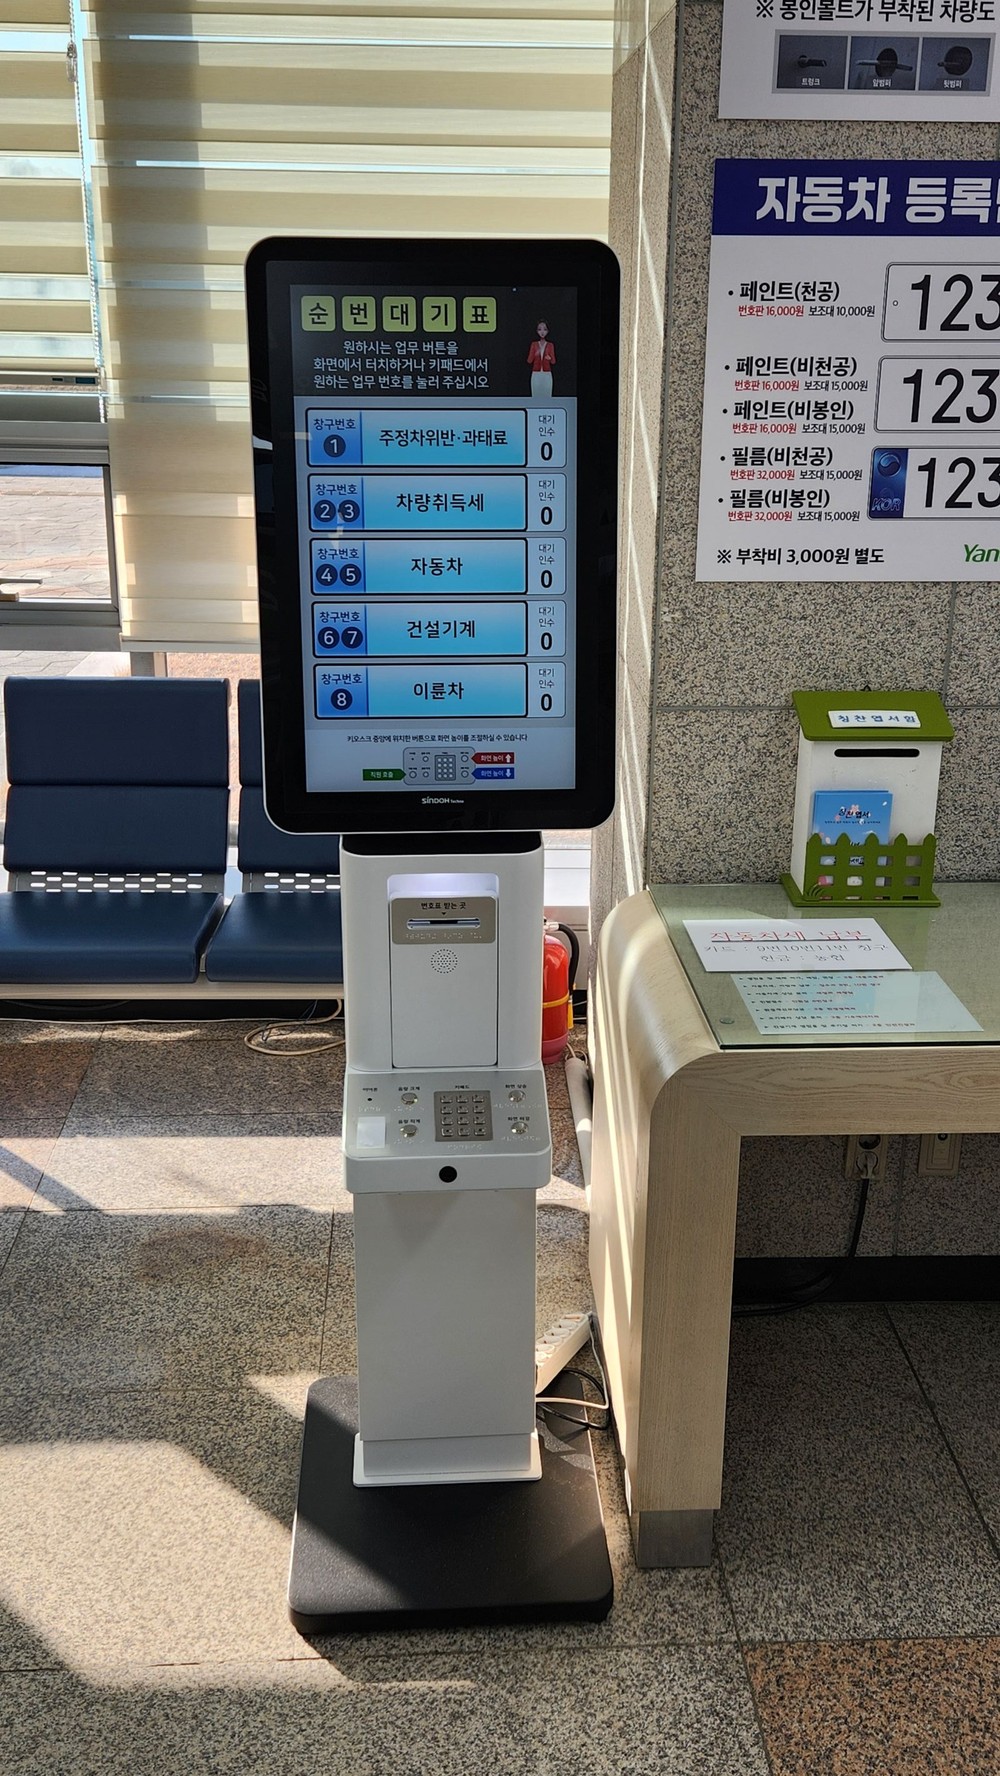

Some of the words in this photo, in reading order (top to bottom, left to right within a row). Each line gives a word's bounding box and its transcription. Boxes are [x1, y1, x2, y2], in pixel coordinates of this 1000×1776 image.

[879, 0, 933, 22] 부착된
[940, 0, 995, 23] 차량도
[802, 77, 821, 86] 트렁크
[872, 78, 892, 88] 앞범퍼
[943, 79, 962, 89] 뒷범퍼
[756, 176, 891, 223] 자동차
[905, 177, 1000, 224] 등록
[739, 280, 841, 302] 페인트(천공)
[910, 273, 1000, 332] 123
[738, 305, 764, 317] 번호판
[765, 305, 805, 318] 16,000원
[808, 306, 835, 317] 보조대
[836, 305, 876, 318] 10,000원
[343, 341, 392, 355] 원하시는
[395, 341, 419, 355] 업무
[423, 341, 459, 355] 버튼을
[313, 358, 362, 372] 화면에서
[366, 358, 426, 372] 터치하거나
[429, 358, 488, 372] 키패드에서
[735, 356, 858, 377] 페인트(비천공)
[313, 375, 349, 389] 원하는
[352, 375, 376, 389] 업무
[379, 375, 414, 389] 번호를
[417, 375, 440, 389] 눌러
[442, 375, 489, 389] 주십시오
[734, 380, 760, 391] 번호판
[761, 380, 800, 392] 16,000원
[804, 380, 830, 391] 보조대
[831, 380, 868, 392] 15,000원
[902, 368, 1000, 424] 123
[733, 399, 855, 420] 페인트(비봉인)
[313, 418, 356, 431] 창구번호
[538, 414, 555, 425] 대기
[538, 426, 555, 437] 인수
[732, 423, 758, 434] 번호판
[759, 423, 797, 435] 16,000원
[802, 423, 828, 434] 보조대
[829, 423, 866, 435] 15,000원
[379, 429, 508, 448] 주정차위반·과태료
[541, 442, 553, 461] 0
[731, 446, 834, 467] 필름(비천공)
[730, 469, 756, 481] 번호판
[757, 469, 796, 481] 32,000원
[799, 470, 825, 481] 보조대
[826, 469, 863, 481] 15,000원
[315, 483, 358, 496] 창구번호
[538, 480, 555, 490] 대기
[396, 493, 485, 513] 차량취득세
[538, 491, 555, 502] 인수
[729, 488, 831, 509] 필름(비봉인)
[871, 497, 902, 512] KOR
[541, 506, 553, 525] 0
[728, 511, 753, 522] 번호판
[754, 511, 793, 523] 32,000원
[797, 511, 823, 522] 보조대
[824, 511, 861, 523] 15,000원
[317, 548, 359, 560] 창구번호
[538, 544, 555, 553] 대기
[538, 555, 555, 565] 인수
[736, 548, 782, 565] 부착비
[786, 548, 851, 565] 3,000원
[854, 548, 885, 564] 별도
[410, 557, 464, 576] 자동차
[541, 569, 553, 588] 0
[319, 611, 361, 623] 창구번호
[538, 606, 555, 616] 대기
[538, 617, 555, 627] 인수
[406, 619, 476, 639] 건설기계
[541, 632, 553, 651] 0
[321, 673, 363, 685] 창구번호
[538, 668, 555, 677] 대기
[538, 679, 555, 689] 인수
[412, 681, 465, 701] 이륜차
[541, 694, 553, 712] 0
[373, 735, 392, 743] 중앙에
[392, 734, 411, 743] 위치한
[412, 734, 436, 742] 버튼으로
[437, 734, 450, 742] 화면
[451, 734, 469, 742] 높이를
[470, 734, 495, 742] 조절하실
[496, 734, 503, 742] 수
[503, 734, 528, 742] 있습니다
[480, 754, 492, 762] 화면
[493, 754, 504, 762] 높이
[480, 769, 492, 777] 화면
[420, 902, 442, 910] 번호표
[443, 902, 457, 910] 받는
[459, 901, 467, 910] 곳
